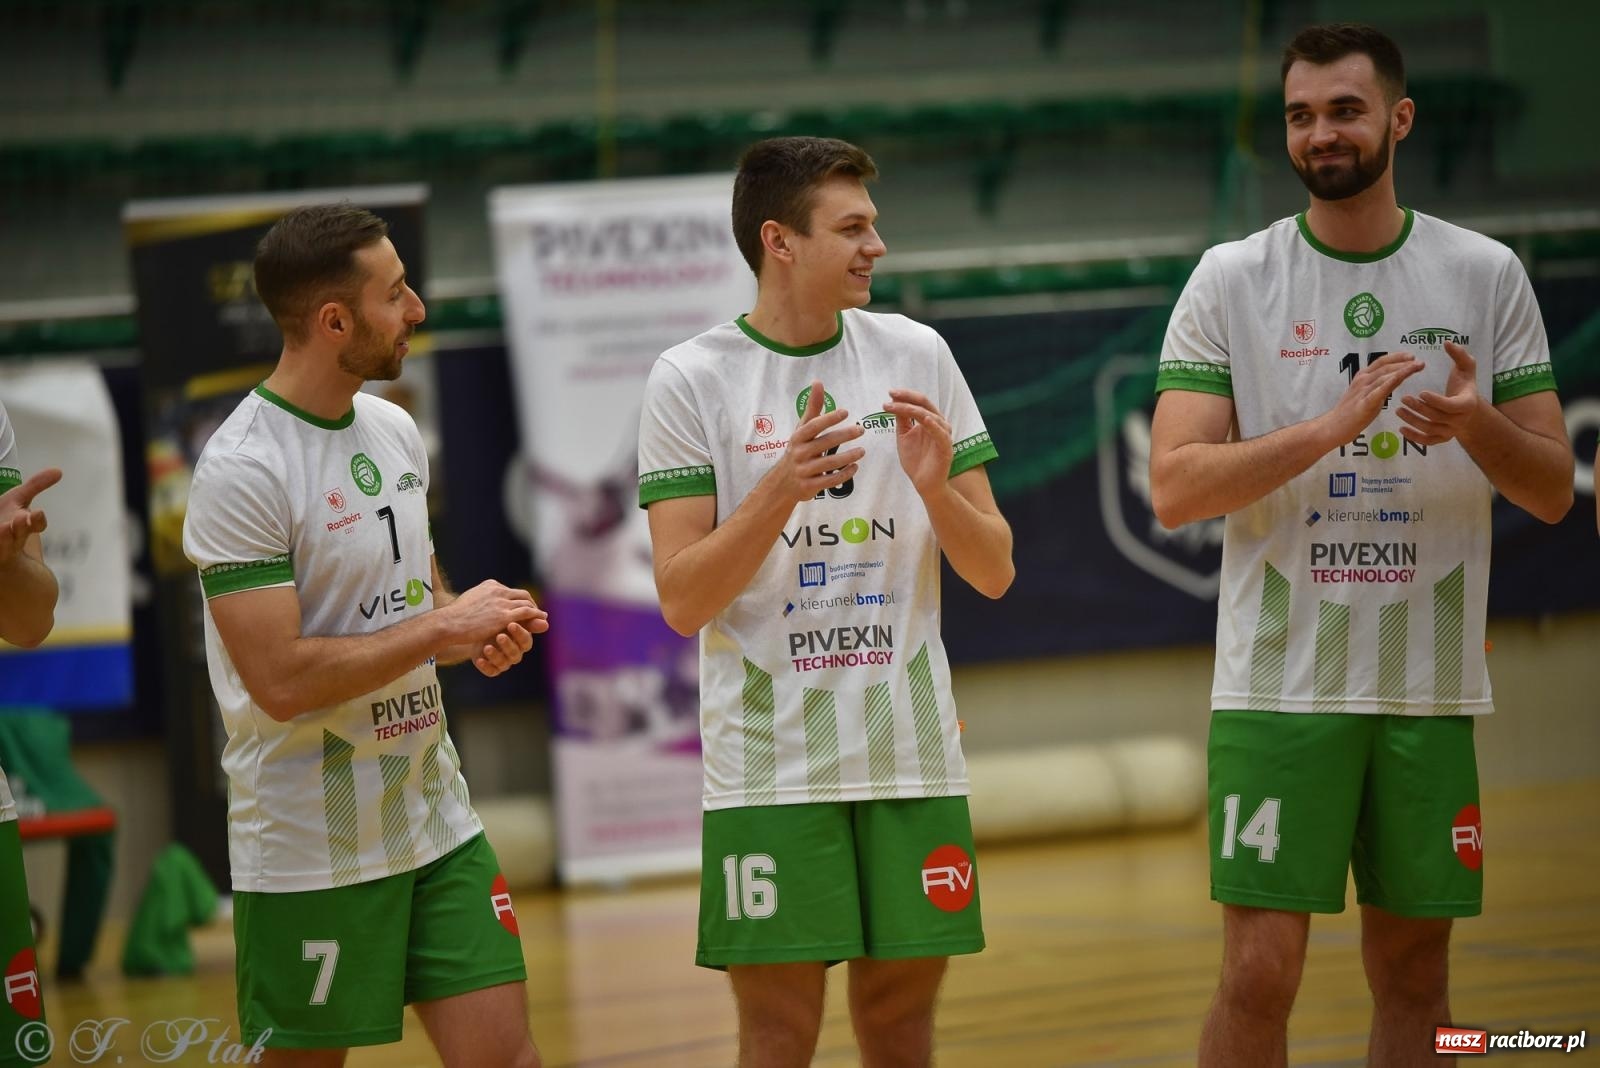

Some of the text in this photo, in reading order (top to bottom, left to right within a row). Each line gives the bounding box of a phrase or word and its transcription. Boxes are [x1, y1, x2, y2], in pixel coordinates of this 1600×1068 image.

[1280, 347, 1330, 359] Racibórz
[326, 513, 363, 532] Racibórz
[780, 517, 897, 549] VISON
[1310, 542, 1417, 567] PIVEXIN
[1310, 569, 1417, 584] TECHNOLOGY
[788, 624, 894, 657] PIVEXIN
[792, 650, 894, 673] TECHNOLOGY
[1221, 793, 1282, 864] 14
[722, 853, 778, 921] 16
[921, 863, 973, 895] RV
[302, 939, 341, 1006] 7
